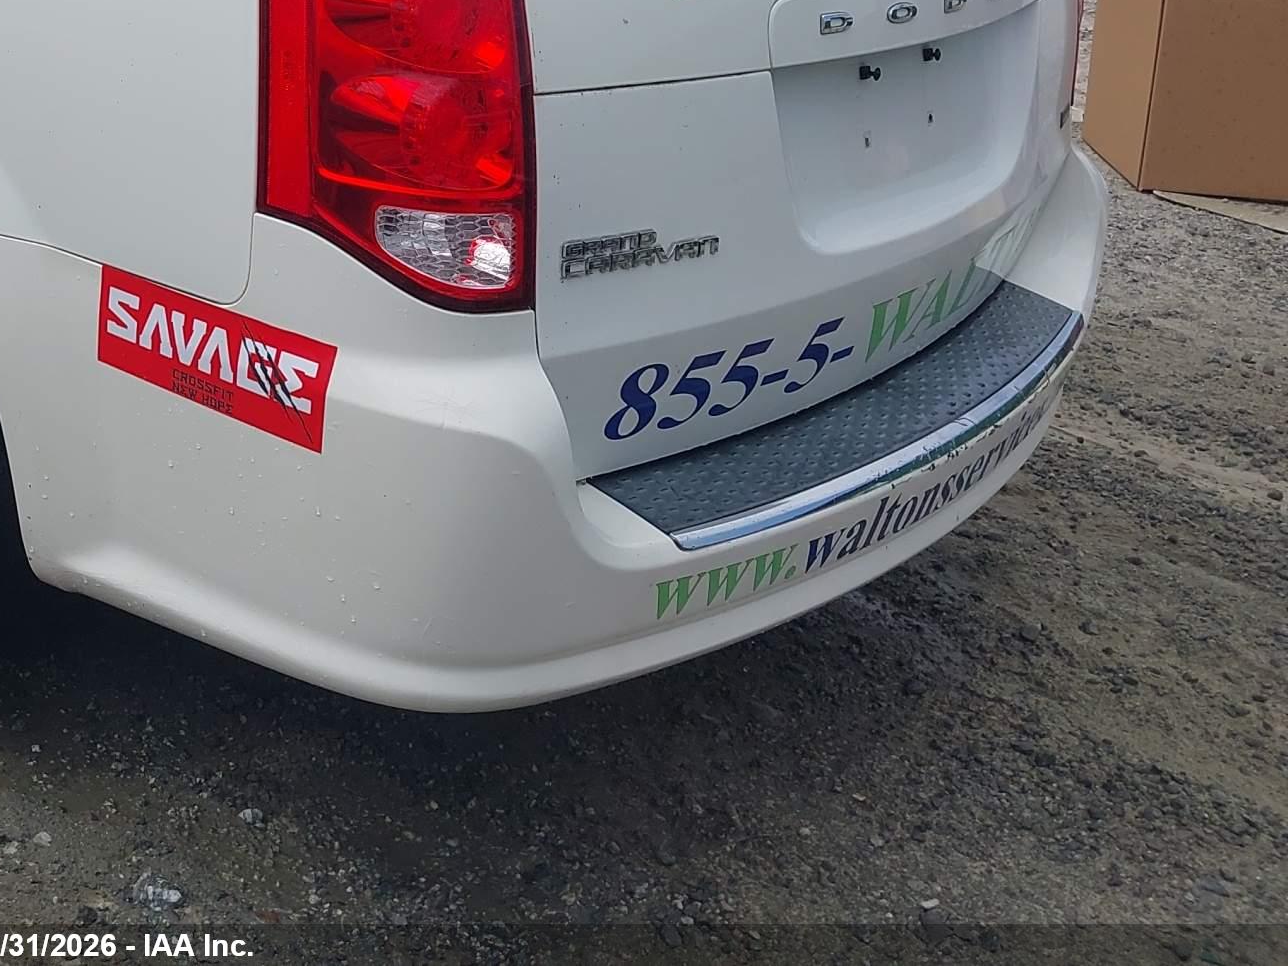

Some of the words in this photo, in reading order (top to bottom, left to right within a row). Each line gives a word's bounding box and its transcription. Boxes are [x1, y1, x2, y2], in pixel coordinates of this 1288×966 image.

[561, 228, 658, 260] GRAND
[561, 235, 720, 281] CARAVAN
[105, 285, 320, 415] SAVAGE
[172, 368, 235, 403] CROSSFIT
